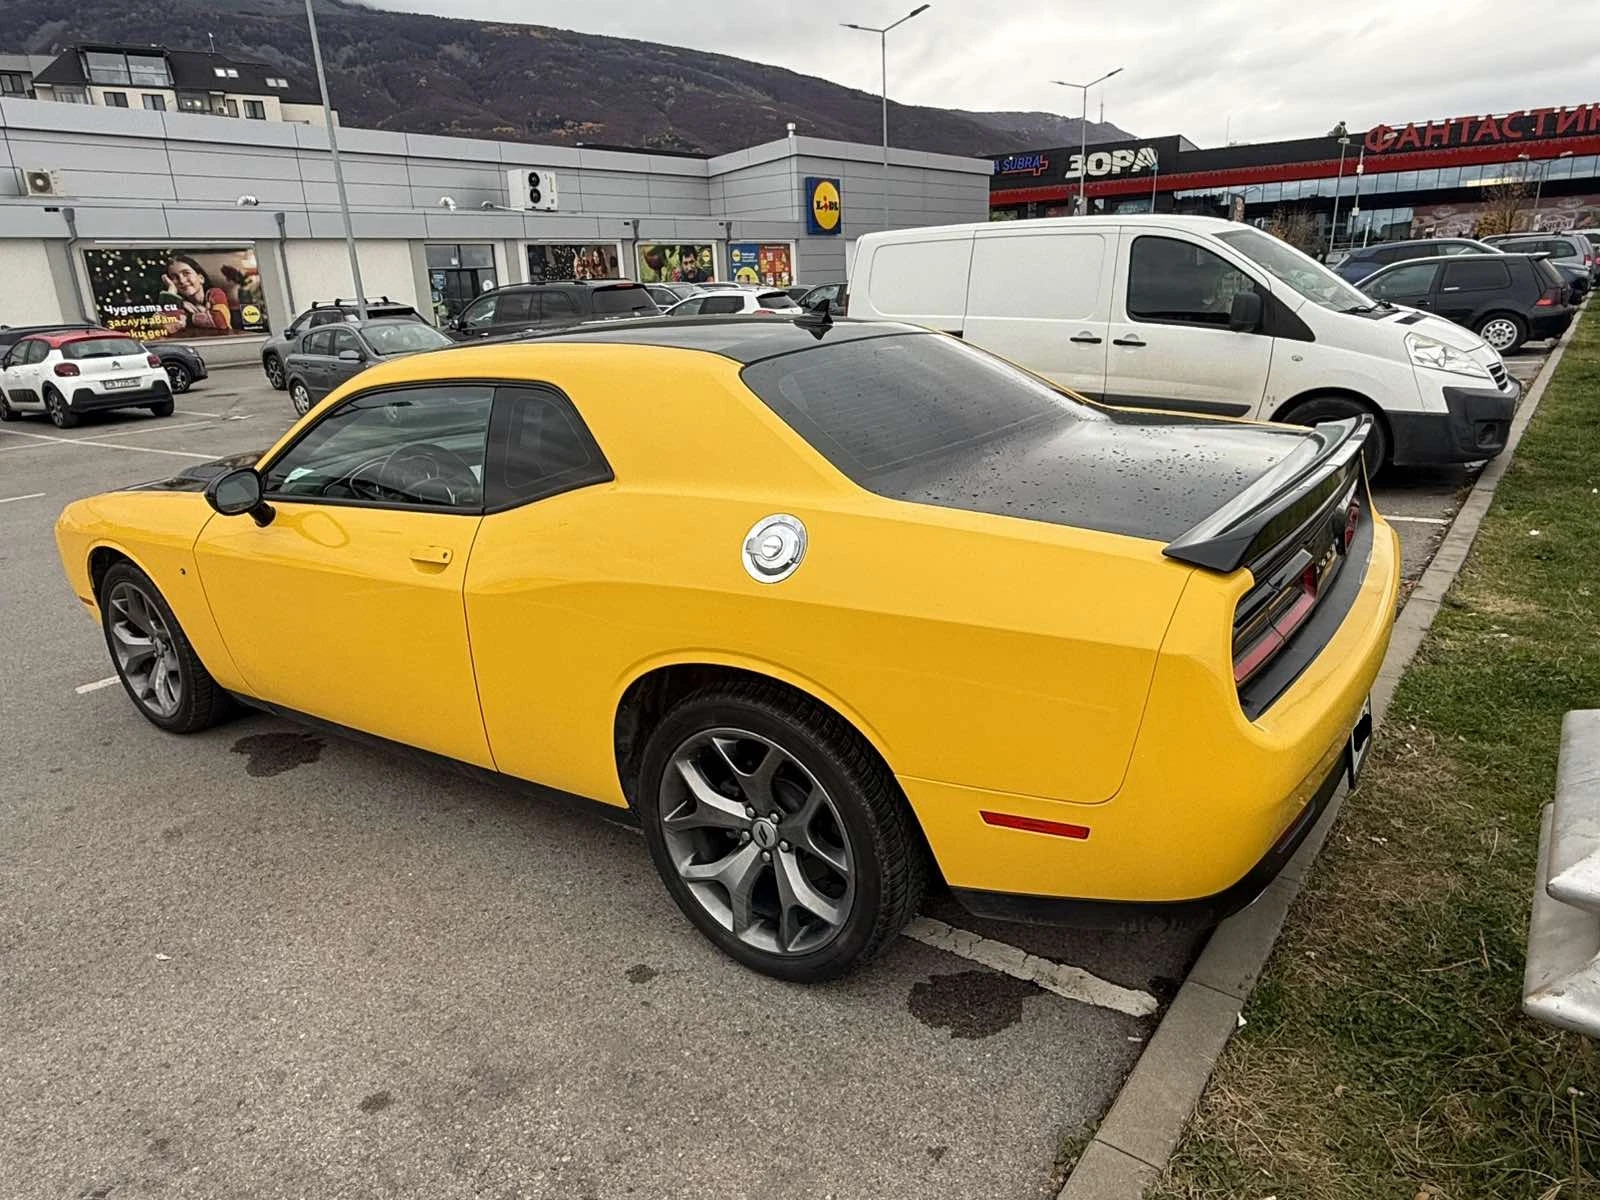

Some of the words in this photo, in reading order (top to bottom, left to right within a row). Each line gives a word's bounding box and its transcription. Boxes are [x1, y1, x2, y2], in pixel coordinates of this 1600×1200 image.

[1002, 155, 1040, 171] SUBRA
[1065, 147, 1157, 179] ЗОРА
[103, 304, 163, 316] Чудесата
[164, 303, 178, 312] си
